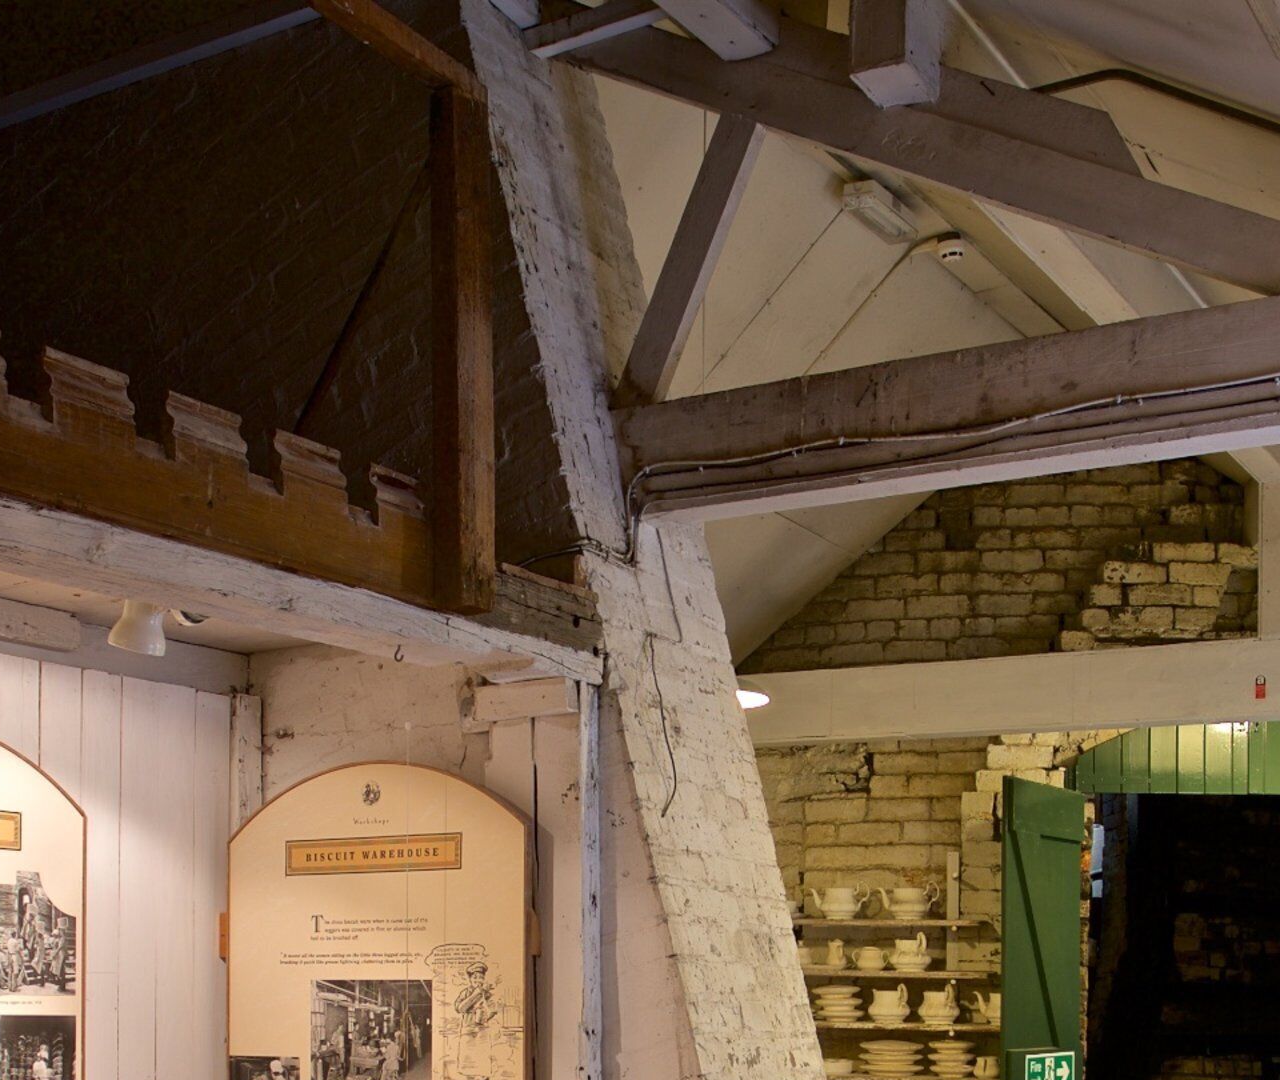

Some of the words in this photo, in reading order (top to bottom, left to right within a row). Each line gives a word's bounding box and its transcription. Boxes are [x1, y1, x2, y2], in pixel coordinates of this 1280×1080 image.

[306, 852, 356, 862] BISCUIT
[362, 848, 440, 859] WAREHOUSE
[1030, 1061, 1042, 1073] Fire
